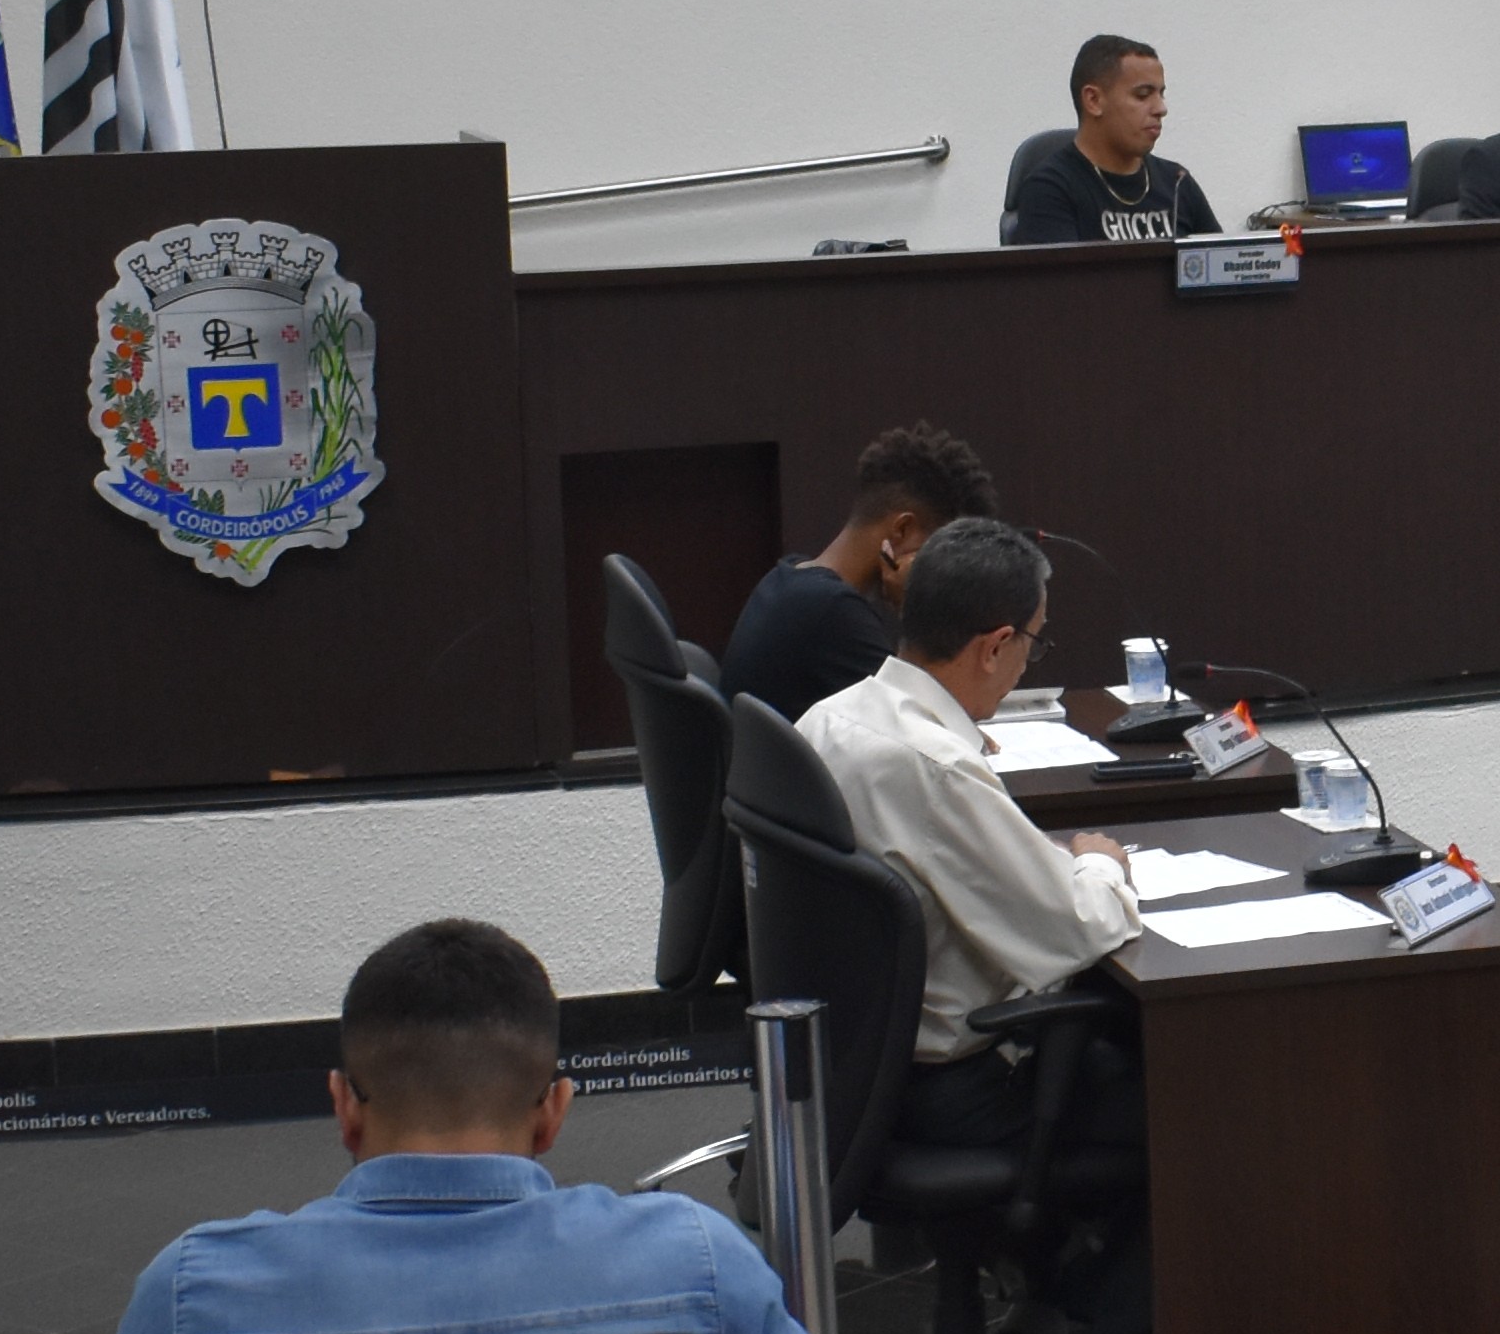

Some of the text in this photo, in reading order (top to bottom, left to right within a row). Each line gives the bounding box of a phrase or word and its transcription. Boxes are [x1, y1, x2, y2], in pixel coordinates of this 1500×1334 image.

[1101, 210, 1173, 241] GUCCI
[128, 481, 160, 506] 1899
[319, 477, 346, 501] 1948
[176, 506, 309, 538] CORDEIRÓPOLIS
[556, 1046, 691, 1070] e Cordeirópolis
[585, 1076, 625, 1094] para
[629, 1066, 740, 1088] funcionários
[743, 1067, 753, 1078] e
[90, 1114, 101, 1126] e
[104, 1106, 211, 1125] Vereadores.
